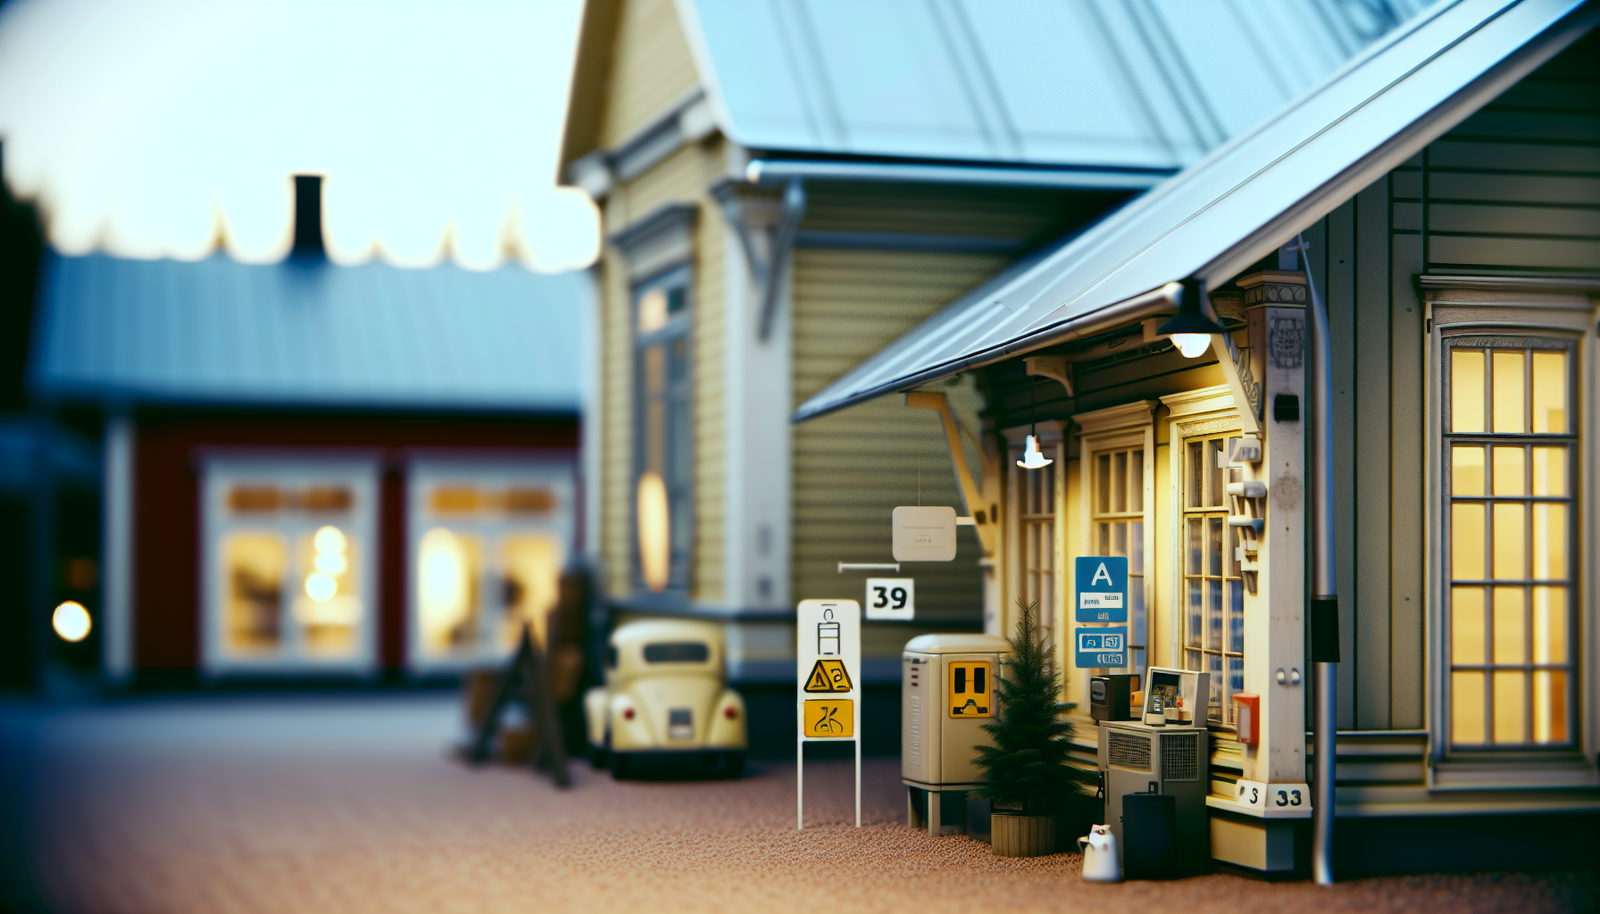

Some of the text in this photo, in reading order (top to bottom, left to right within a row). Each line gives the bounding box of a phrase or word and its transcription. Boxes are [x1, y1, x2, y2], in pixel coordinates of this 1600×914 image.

[1091, 562, 1113, 586] A
[873, 586, 907, 609] 39
[1276, 789, 1302, 806] 33
